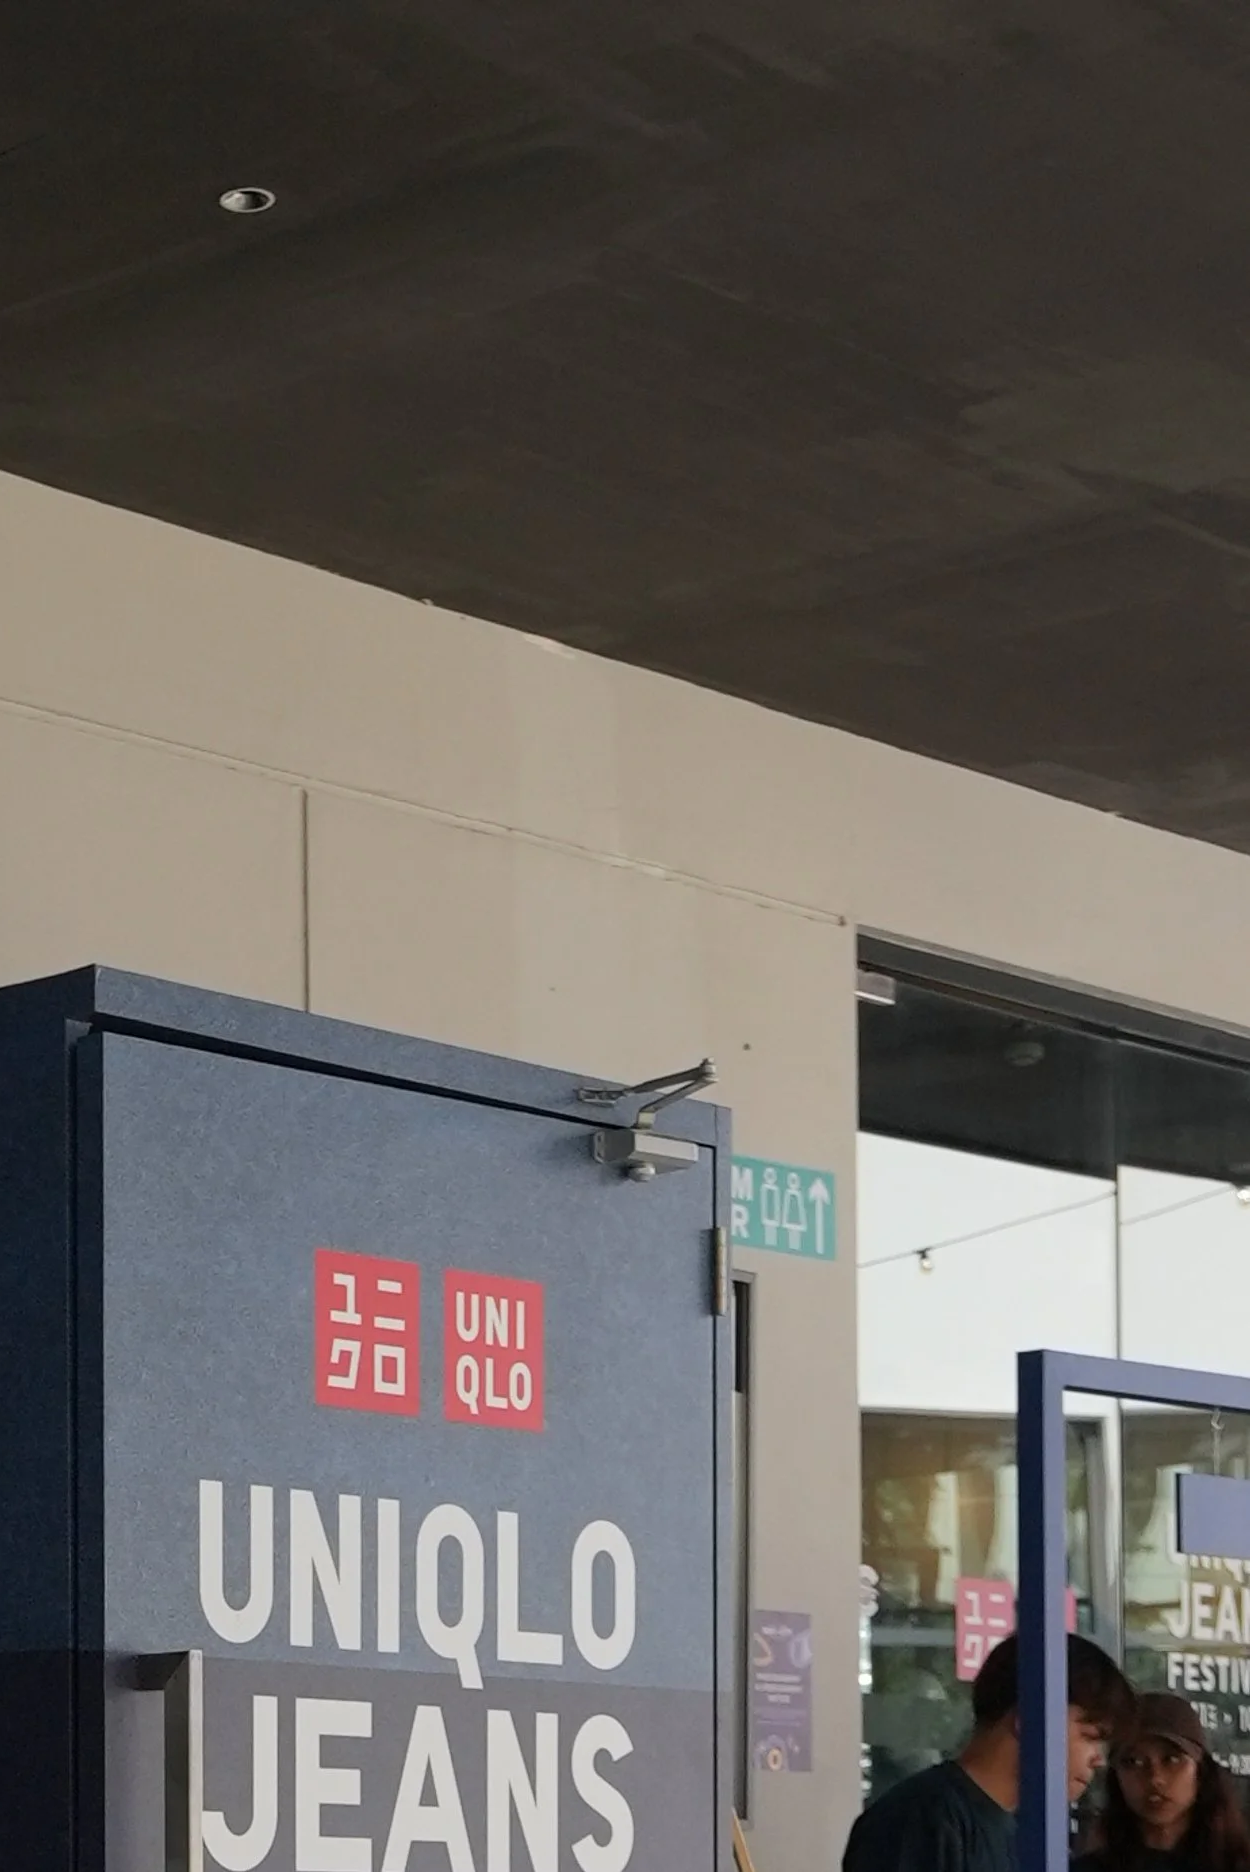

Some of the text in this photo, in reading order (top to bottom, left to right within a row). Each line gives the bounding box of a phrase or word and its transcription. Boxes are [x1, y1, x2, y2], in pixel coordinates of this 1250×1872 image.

[456, 1291, 525, 1350] UNI
[456, 1355, 532, 1415] QLO
[199, 1479, 636, 1690] UNIQLO
